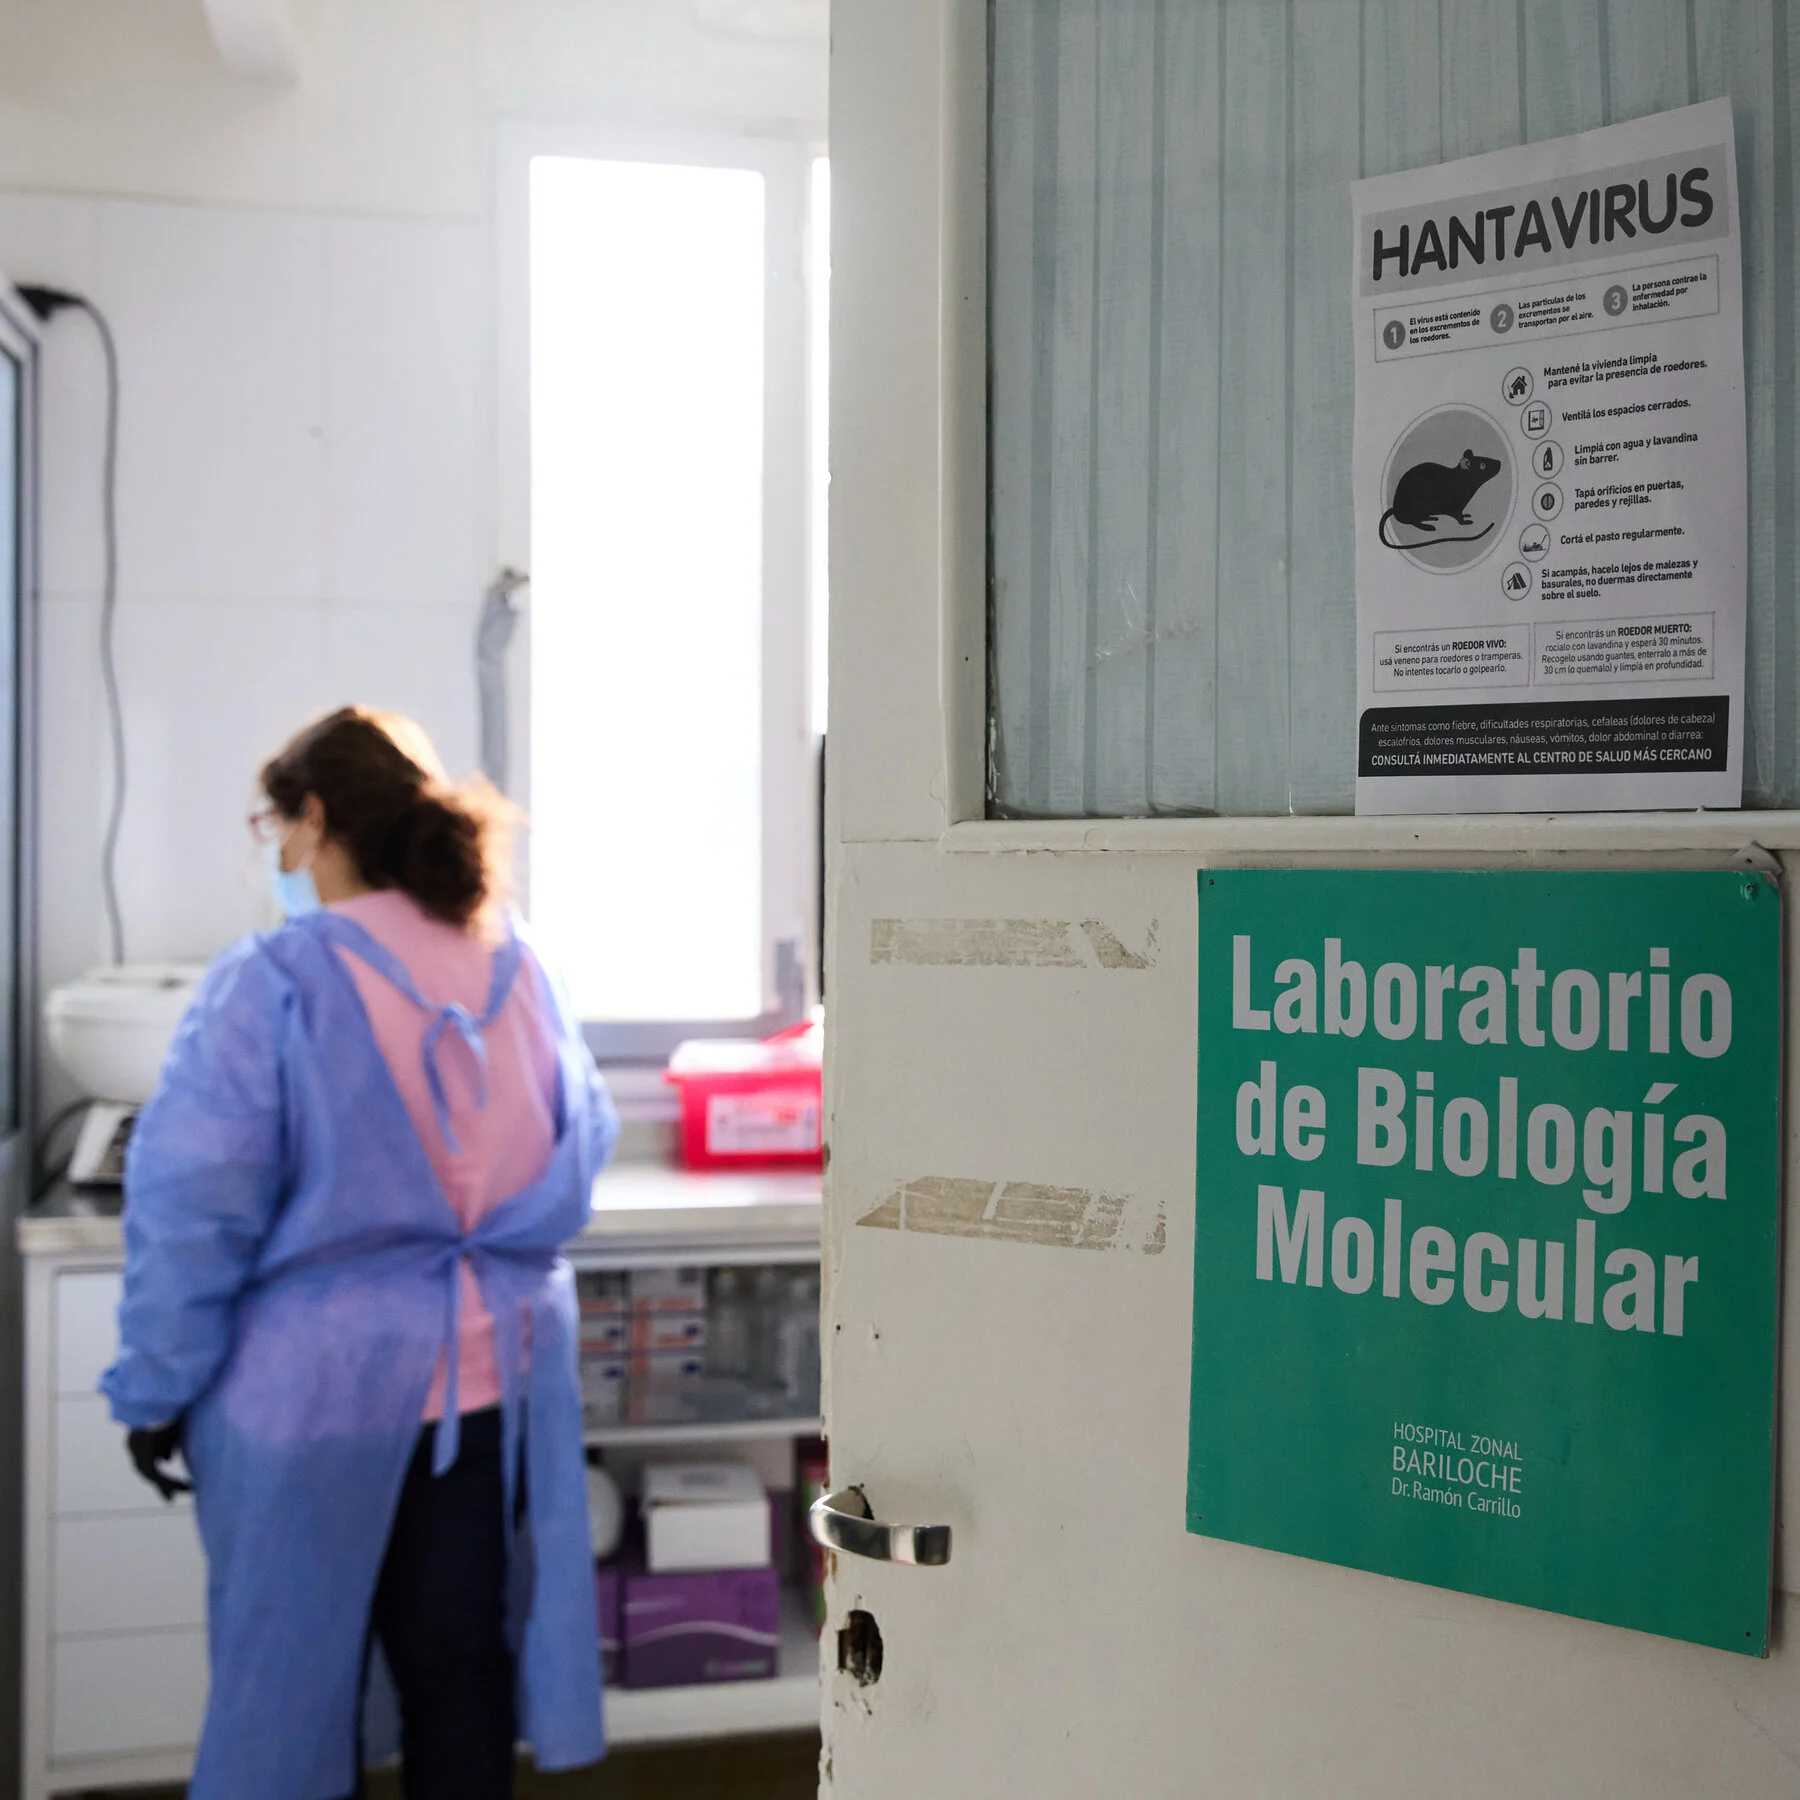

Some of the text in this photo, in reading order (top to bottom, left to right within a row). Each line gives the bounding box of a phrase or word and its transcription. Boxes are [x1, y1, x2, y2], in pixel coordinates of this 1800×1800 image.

[1373, 167, 1714, 281] HANTAVIRUS
[1632, 273, 1707, 292] La persona contrae la
[1518, 302, 1531, 310] Las
[1565, 294, 1575, 302] de
[1575, 293, 1586, 301] los
[1612, 292, 1620, 310] 3
[1632, 287, 1688, 302] enfermedad por
[1518, 307, 1561, 319] excrementos
[1632, 299, 1670, 311] inhalación.
[1409, 317, 1417, 326] El
[1434, 313, 1449, 322] está
[1449, 308, 1481, 320] contenido
[1418, 326, 1429, 334] los
[1429, 320, 1471, 332] excrementos
[1471, 318, 1480, 326] de
[1497, 310, 1507, 328] 2
[1518, 311, 1594, 329] transportan por el aire.
[1391, 327, 1397, 344] 1
[1420, 333, 1451, 342] roedores.
[1543, 352, 1658, 377] Mantené la vivienda limpia
[1548, 360, 1708, 390] para evitar la presencia de roedores.
[1562, 398, 1691, 422] Ventilá los espacios cerrados.
[1574, 432, 1698, 455] Limpiá con agua y lavandina
[1574, 454, 1619, 466] sin barrer.
[1574, 480, 1684, 500] Tapá orificios en puertas,
[1574, 494, 1652, 512] paredes y rejillas.
[1560, 526, 1685, 545] Cortá el pasto regularmente.
[1541, 560, 1698, 578] Si acampás, hacelo lejos de malezas y
[1541, 570, 1693, 589] basurales, no duermas directamente
[1541, 588, 1601, 601] sobre el suelo.
[1555, 623, 1692, 640] Si encontrás un ROEDOR MUERTO:
[1394, 639, 1507, 654] Si encontrás un ROEDOR VIVO:
[1571, 643, 1586, 651] con
[1587, 640, 1624, 650] lavandina
[1624, 641, 1630, 650] y
[1630, 637, 1657, 649] esperá
[1658, 636, 1669, 646] 30
[1393, 657, 1421, 665] veneno
[1421, 656, 1439, 666] para
[1440, 653, 1473, 663] roedores
[1474, 654, 1480, 662] o
[1541, 653, 1576, 665] Recogelo
[1577, 652, 1605, 662] usando
[1605, 651, 1636, 663] guantes,
[1637, 648, 1672, 659] enterralo
[1678, 647, 1696, 657] más
[1697, 646, 1707, 656] de
[1393, 668, 1404, 677] No
[1405, 668, 1435, 676] intentes
[1435, 665, 1462, 675] tocarlo
[1462, 666, 1468, 674] o
[1543, 665, 1554, 675] 30
[1567, 665, 1575, 674] (o
[1613, 665, 1619, 674] y
[1644, 662, 1654, 671] en
[1371, 723, 1389, 732] Ante
[1428, 722, 1451, 731] como
[1452, 720, 1478, 731] fiebre,
[1479, 719, 1529, 730] dificultades
[1531, 718, 1589, 730] respiratorias,
[1591, 716, 1629, 727] cefaleas
[1630, 715, 1666, 726] (dolores
[1667, 714, 1679, 725] de
[1680, 713, 1715, 724] cabeza)
[1423, 736, 1454, 746] dolores
[1456, 734, 1509, 745] musculares,
[1510, 733, 1548, 745] náuseas,
[1549, 732, 1587, 744] vómitos,
[1588, 732, 1612, 743] dolor
[1613, 730, 1659, 742] abdominal
[1661, 732, 1667, 740] o
[1371, 746, 1712, 766] CONSULTÁ INMEDIATAMENTE AL CENTRO DE SALUD MÁS CERCANO
[1232, 935, 1733, 1059] Laboratorio
[1235, 1061, 1728, 1213] de Biología
[1256, 1185, 1698, 1337] Molecular
[1394, 1422, 1523, 1460] HOSPITAL ZONAL
[1393, 1446, 1522, 1494] BARILOCHE
[1392, 1477, 1520, 1518] Dr. Ramón Carrillo
